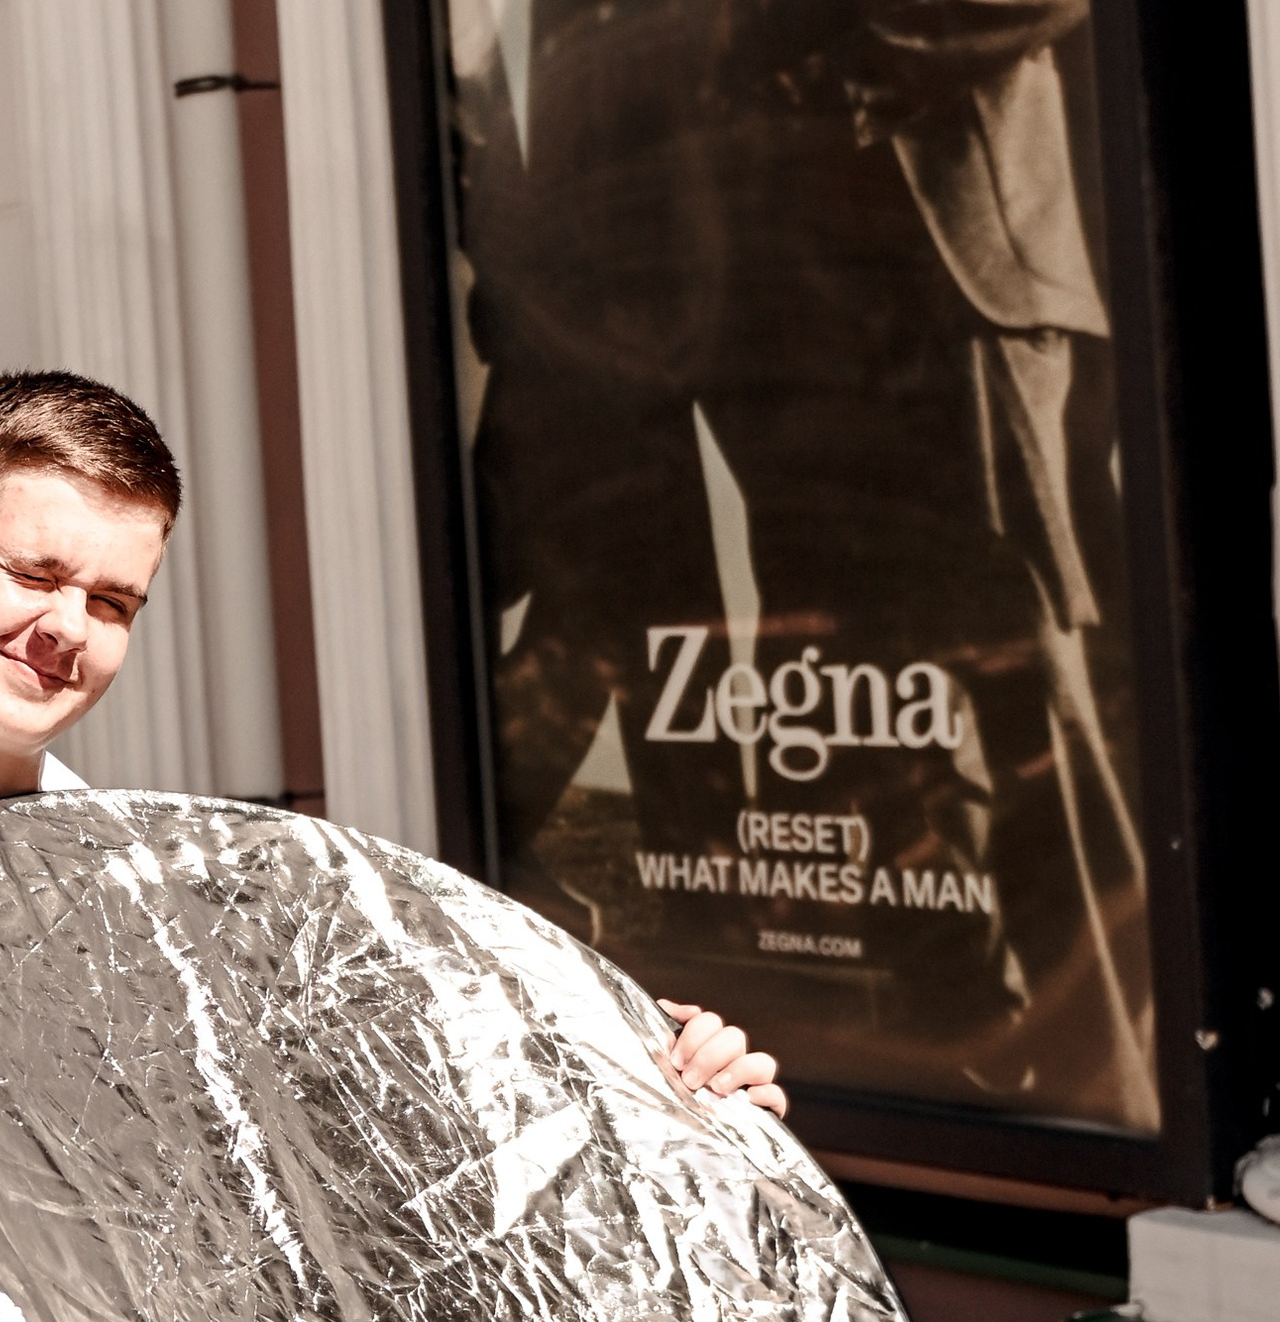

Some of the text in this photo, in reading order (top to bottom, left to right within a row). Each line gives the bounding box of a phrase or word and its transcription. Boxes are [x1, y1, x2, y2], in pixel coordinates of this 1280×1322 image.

[645, 626, 964, 782] Zegna
[737, 809, 871, 862] (RESET)
[636, 852, 995, 914] WHAT MAKES A MAN
[757, 930, 863, 959] ZEGNA.COM
